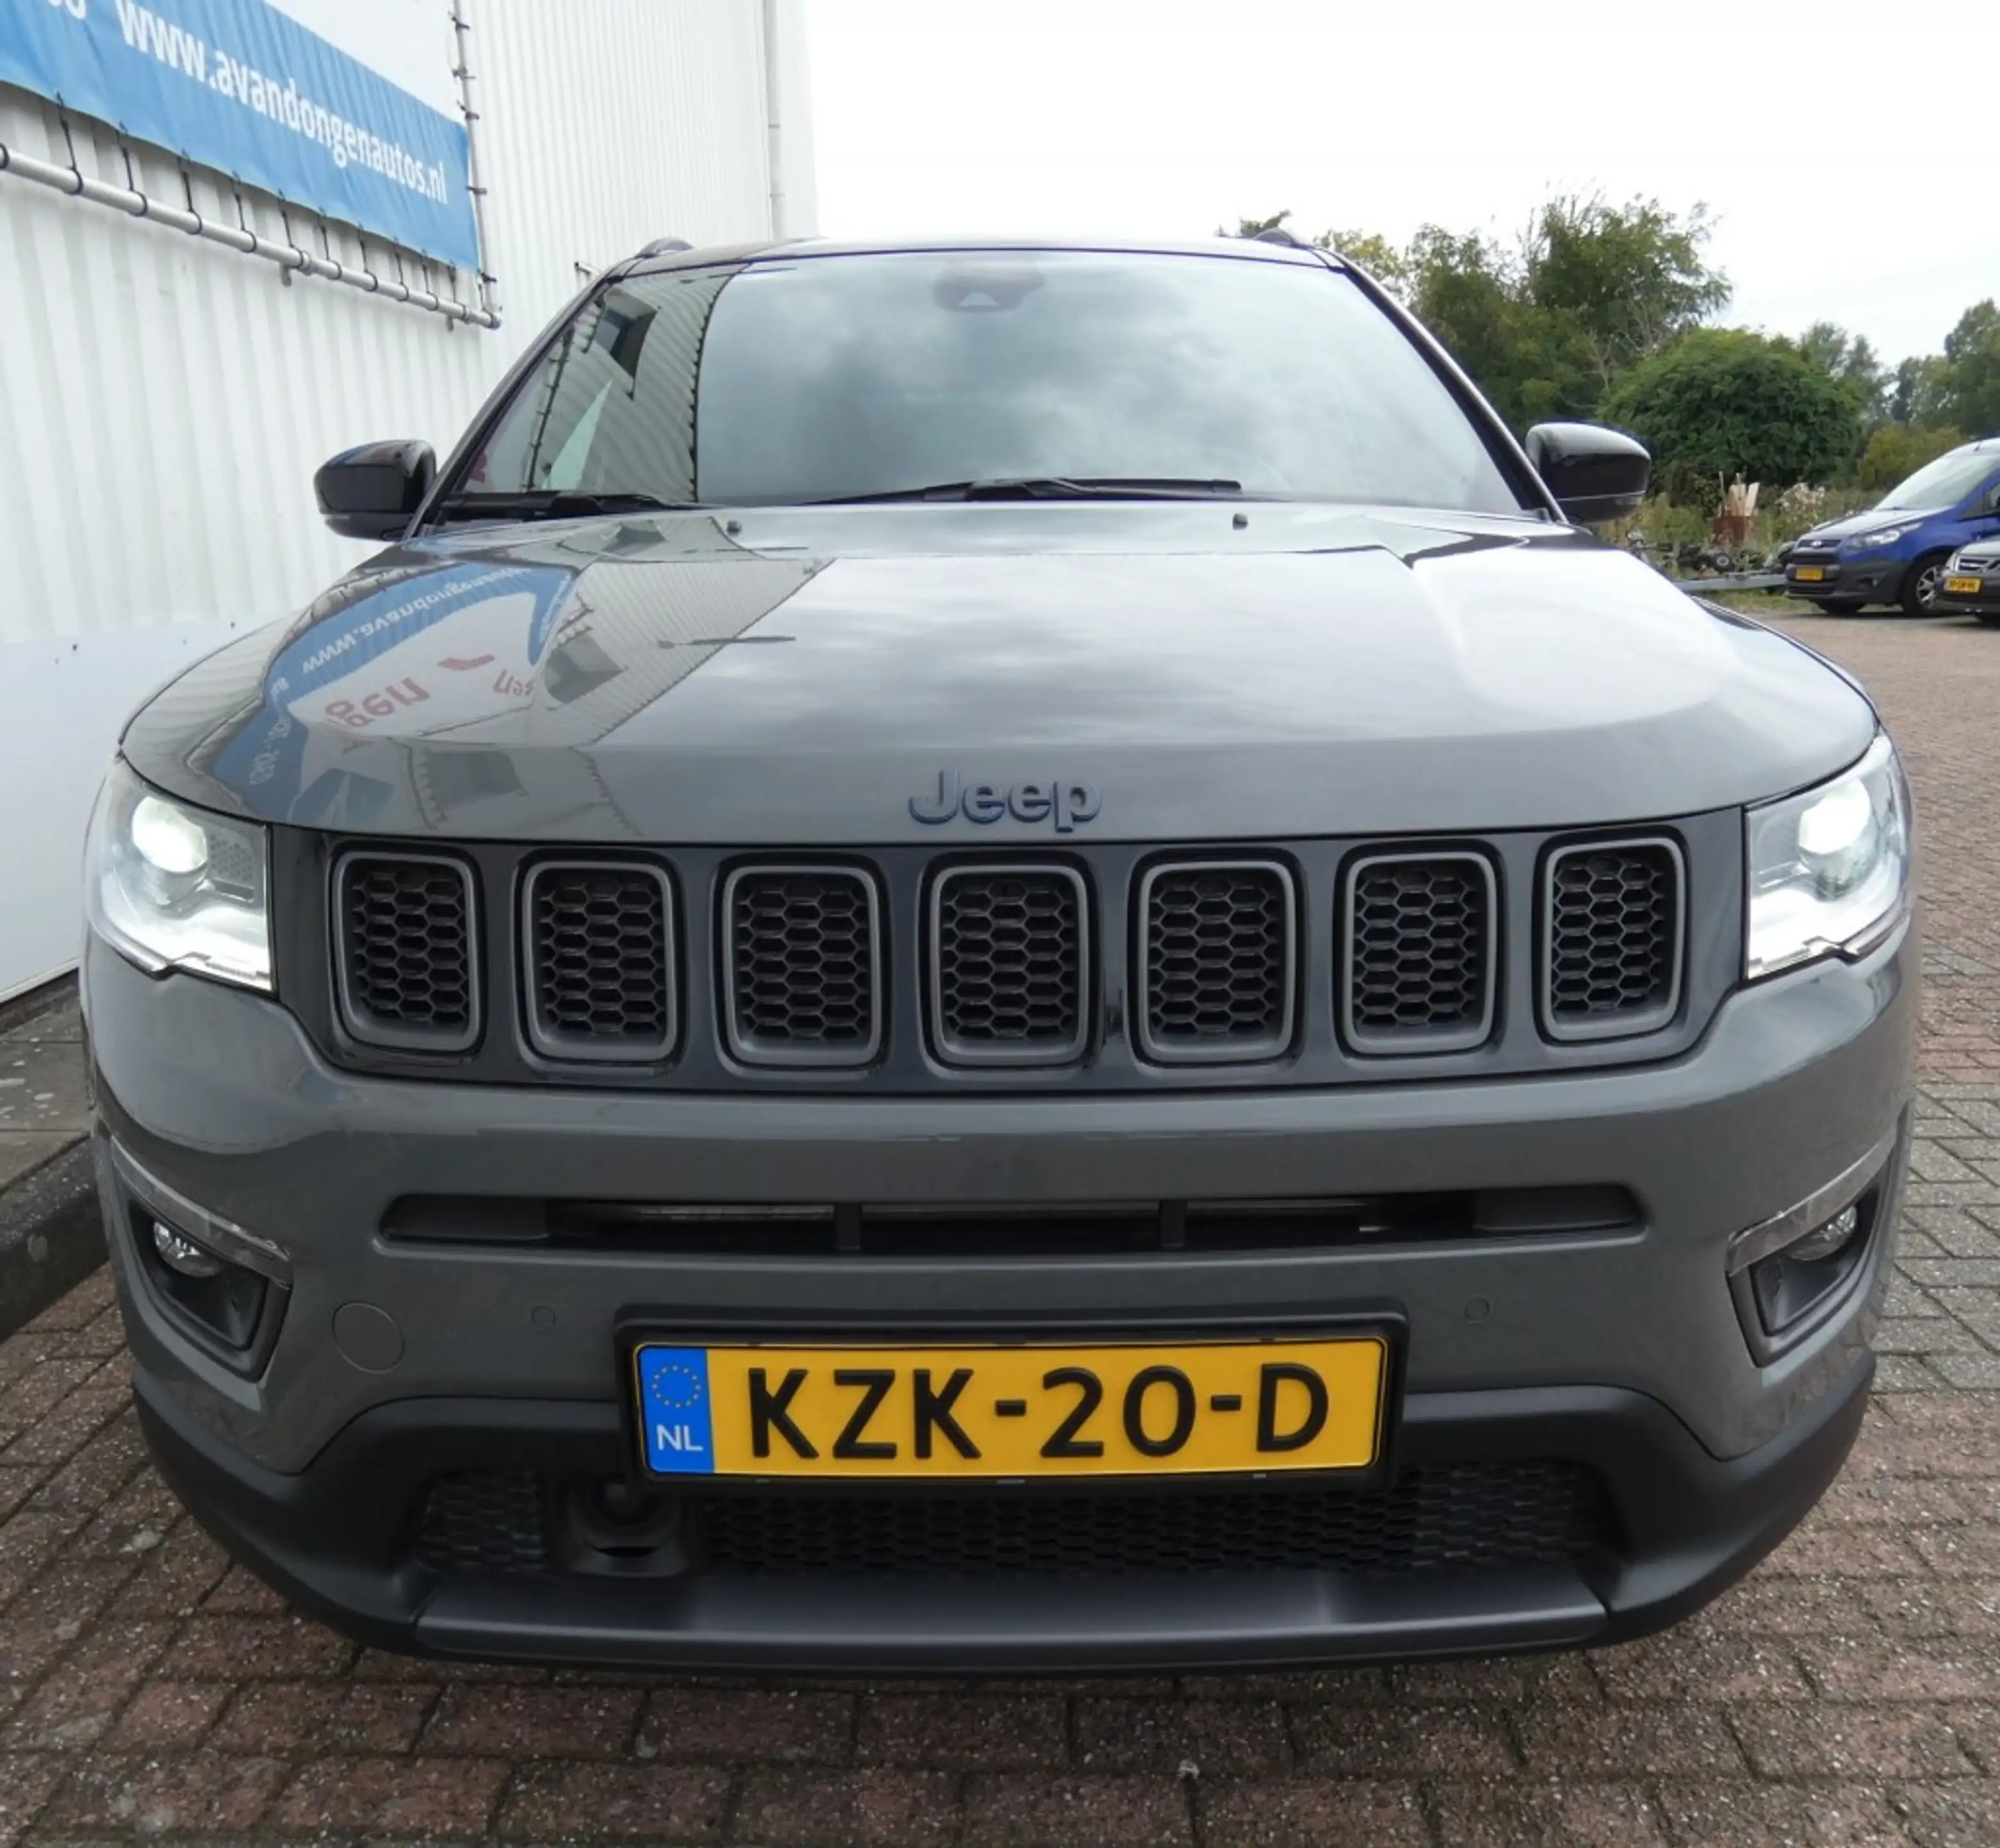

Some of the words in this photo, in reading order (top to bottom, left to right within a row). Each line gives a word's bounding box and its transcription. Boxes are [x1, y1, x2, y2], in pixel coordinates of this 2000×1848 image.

[115, 0, 448, 204] www.avandongenautos.nl
[908, 769, 1103, 833] Jeep
[656, 1423, 704, 1452] NL
[748, 1363, 1329, 1460] KZK-20-D
